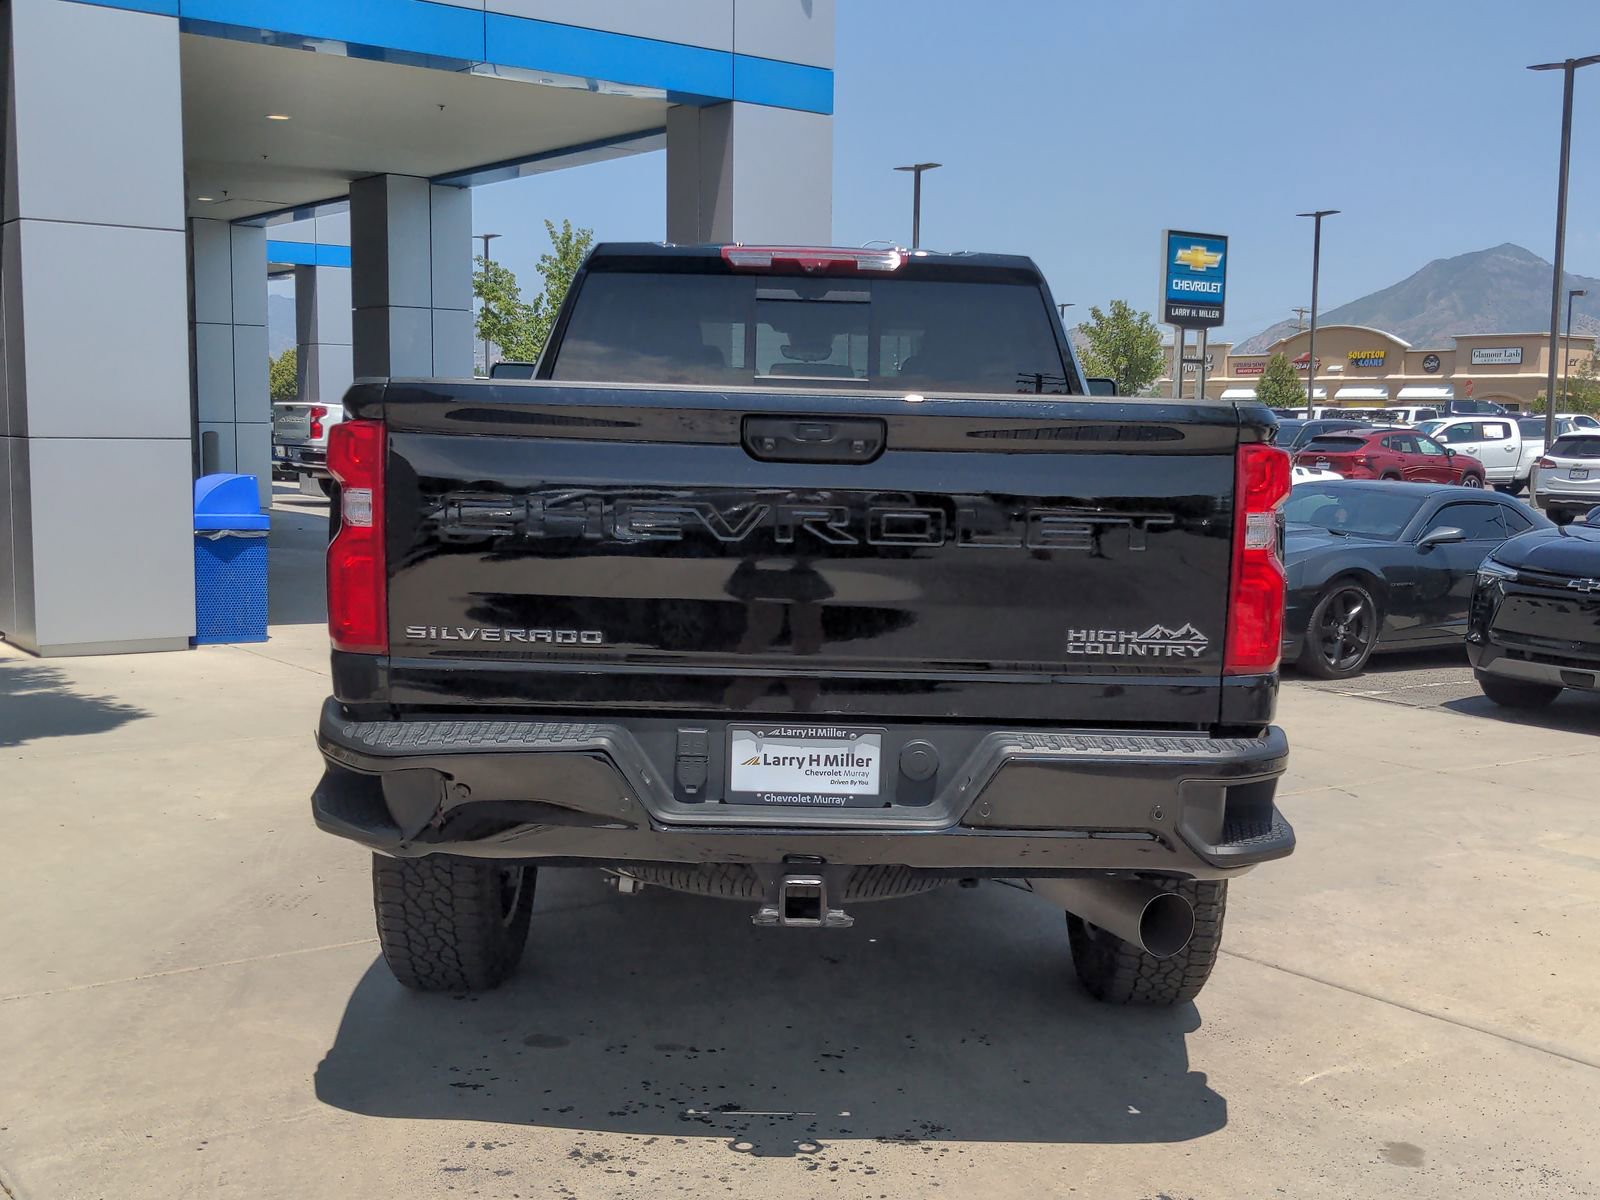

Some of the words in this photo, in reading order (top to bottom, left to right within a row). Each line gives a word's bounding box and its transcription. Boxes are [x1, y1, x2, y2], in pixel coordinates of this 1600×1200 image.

[1173, 279, 1223, 293] CHEVROLET
[1171, 308, 1189, 317] LARRY
[1191, 309, 1197, 317] H.
[1199, 309, 1219, 318] MILLER
[1347, 351, 1385, 359] SOLUTION
[1473, 350, 1502, 359] Glamour
[1504, 349, 1520, 358] Lash
[1359, 359, 1383, 367] LOANS
[442, 492, 1173, 550] CHEVROLET
[406, 625, 603, 644] SILVERADO
[1067, 629, 1138, 643] HIGH
[1067, 642, 1207, 657] COUNTRY
[781, 728, 807, 738] Larry
[808, 728, 816, 737] H
[817, 728, 847, 738] Miller
[763, 753, 805, 769] Larry
[809, 754, 821, 767] H
[824, 754, 872, 768] Miller
[804, 769, 842, 777] Chevrolet
[843, 770, 870, 778] Murray
[764, 793, 812, 803] Chevrolet
[813, 794, 846, 805] Murray
